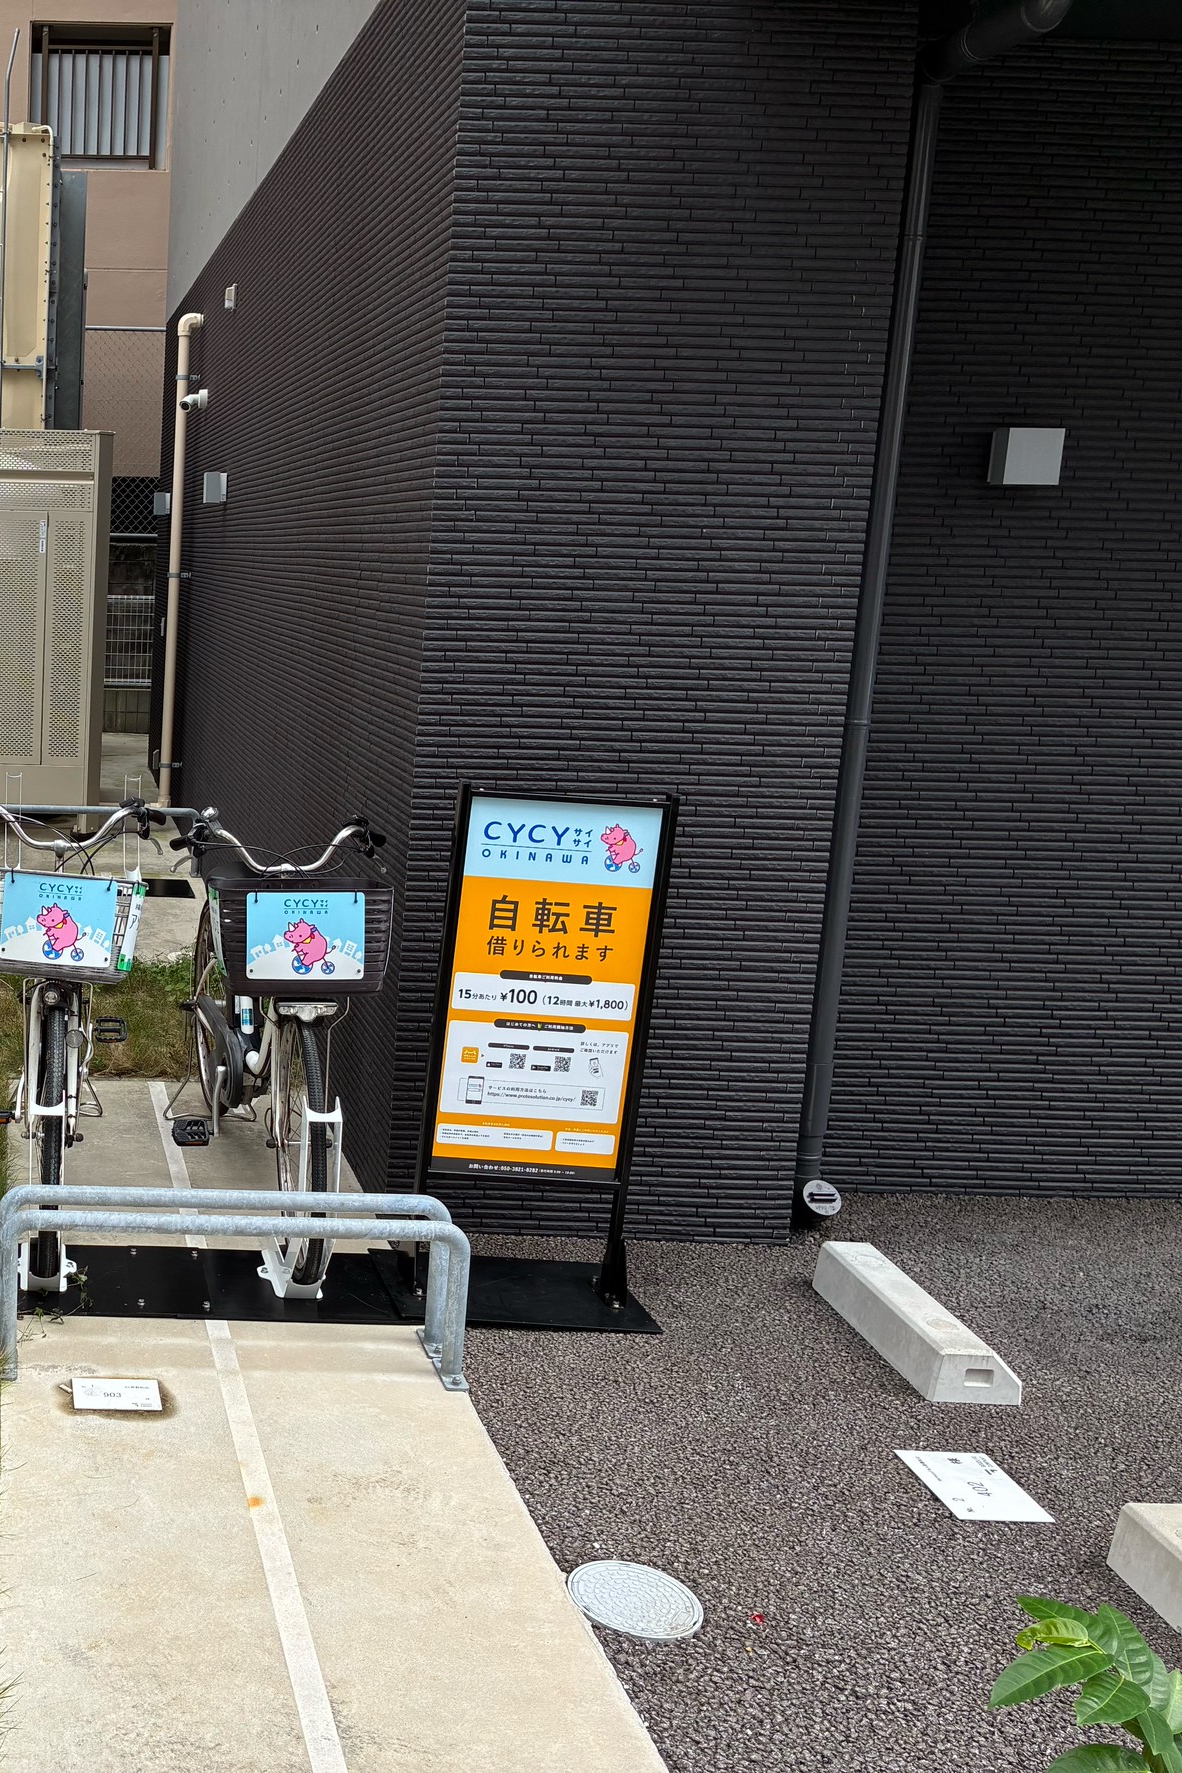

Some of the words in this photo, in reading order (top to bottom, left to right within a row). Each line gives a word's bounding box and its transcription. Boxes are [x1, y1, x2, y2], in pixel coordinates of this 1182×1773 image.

[483, 820, 570, 846] CYCY
[574, 828, 593, 838] サイ
[573, 838, 592, 848] サイ
[482, 848, 589, 865] OKINAWA
[39, 882, 74, 893] CYCY
[284, 899, 318, 908] CYCY
[488, 895, 617, 937] 自転車
[487, 935, 613, 962] 借りられます
